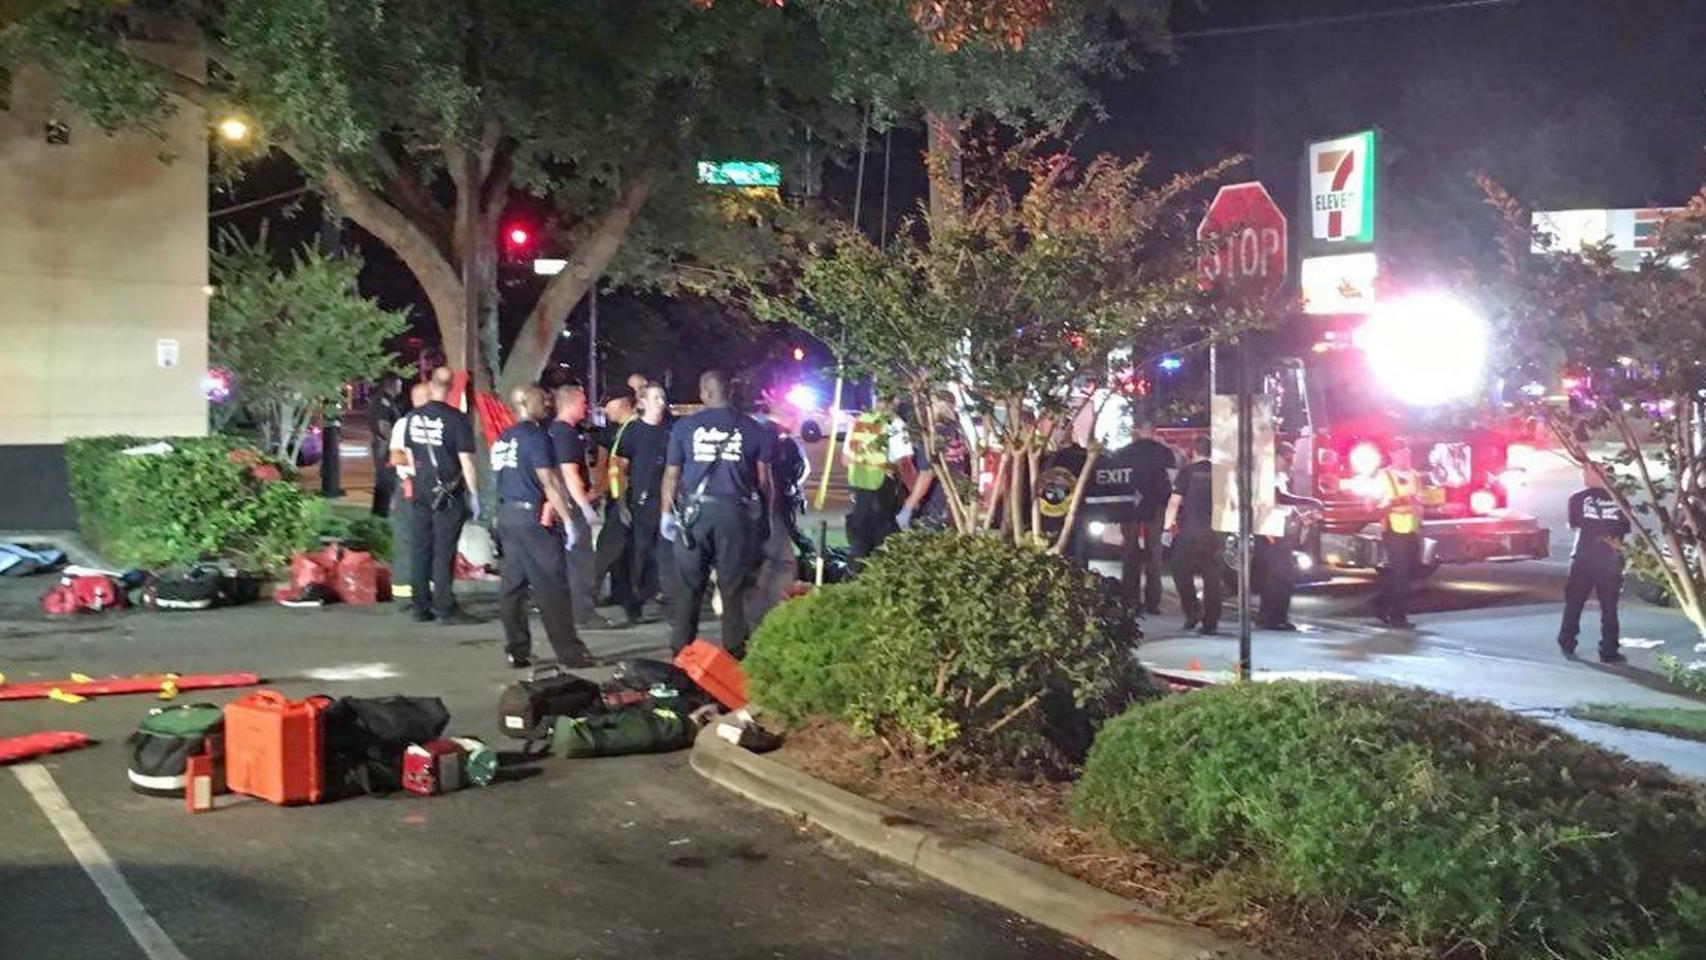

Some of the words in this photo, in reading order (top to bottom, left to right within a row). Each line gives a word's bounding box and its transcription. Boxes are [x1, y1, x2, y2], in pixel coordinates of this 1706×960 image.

[1318, 150, 1354, 238] 7
[1202, 227, 1280, 280] STOP
[1096, 468, 1133, 484] EXIT
